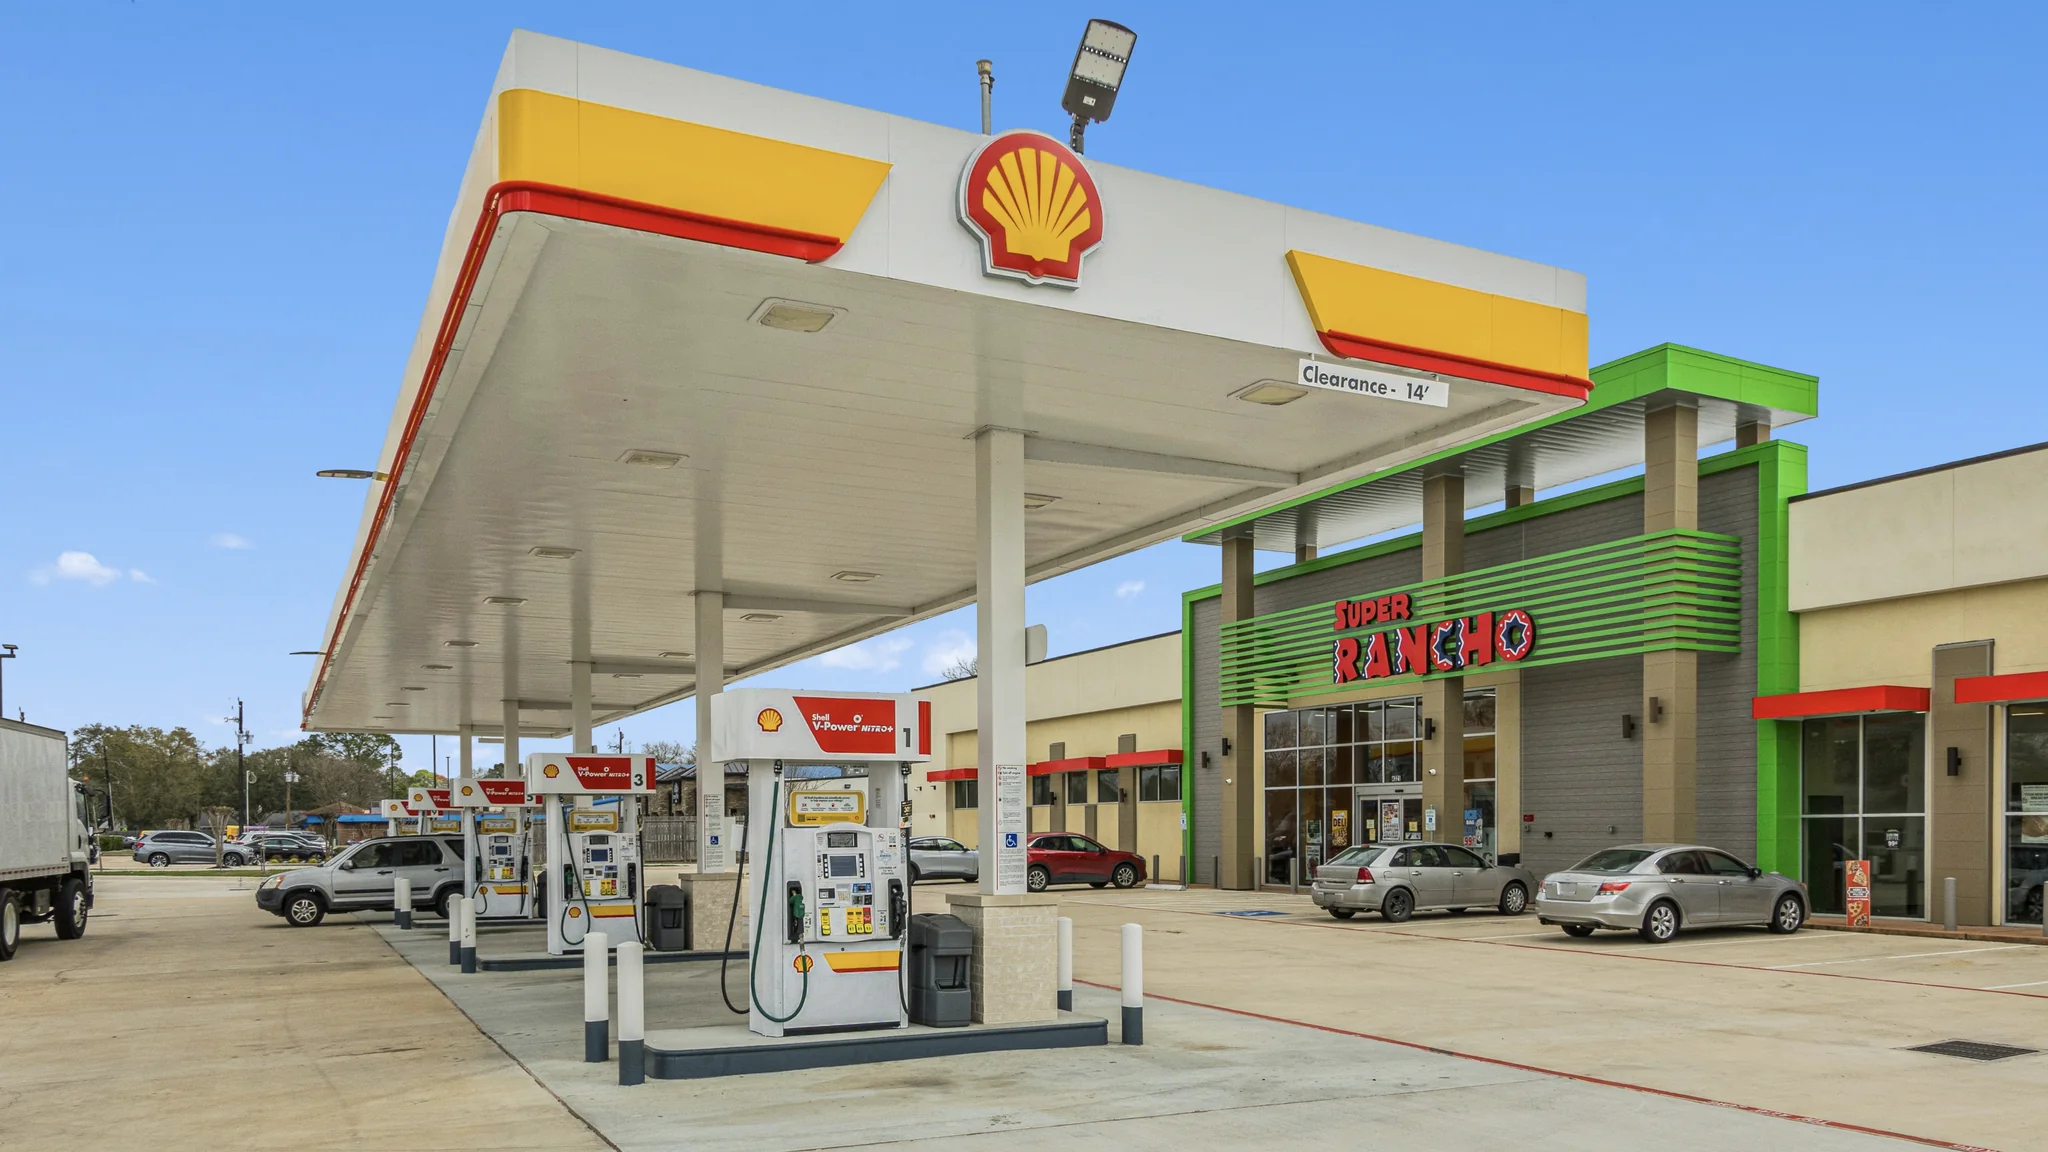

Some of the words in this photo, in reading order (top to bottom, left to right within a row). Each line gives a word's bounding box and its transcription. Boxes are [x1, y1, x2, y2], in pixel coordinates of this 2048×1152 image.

[1406, 382, 1430, 401] 14'
[1333, 593, 1412, 631] SUPER
[1332, 609, 1534, 684] RANCHO
[811, 713, 830, 721] Shell
[812, 721, 858, 732] V-Power
[902, 727, 911, 748] 1
[633, 773, 644, 787] 3
[1333, 818, 1346, 827] DELI
